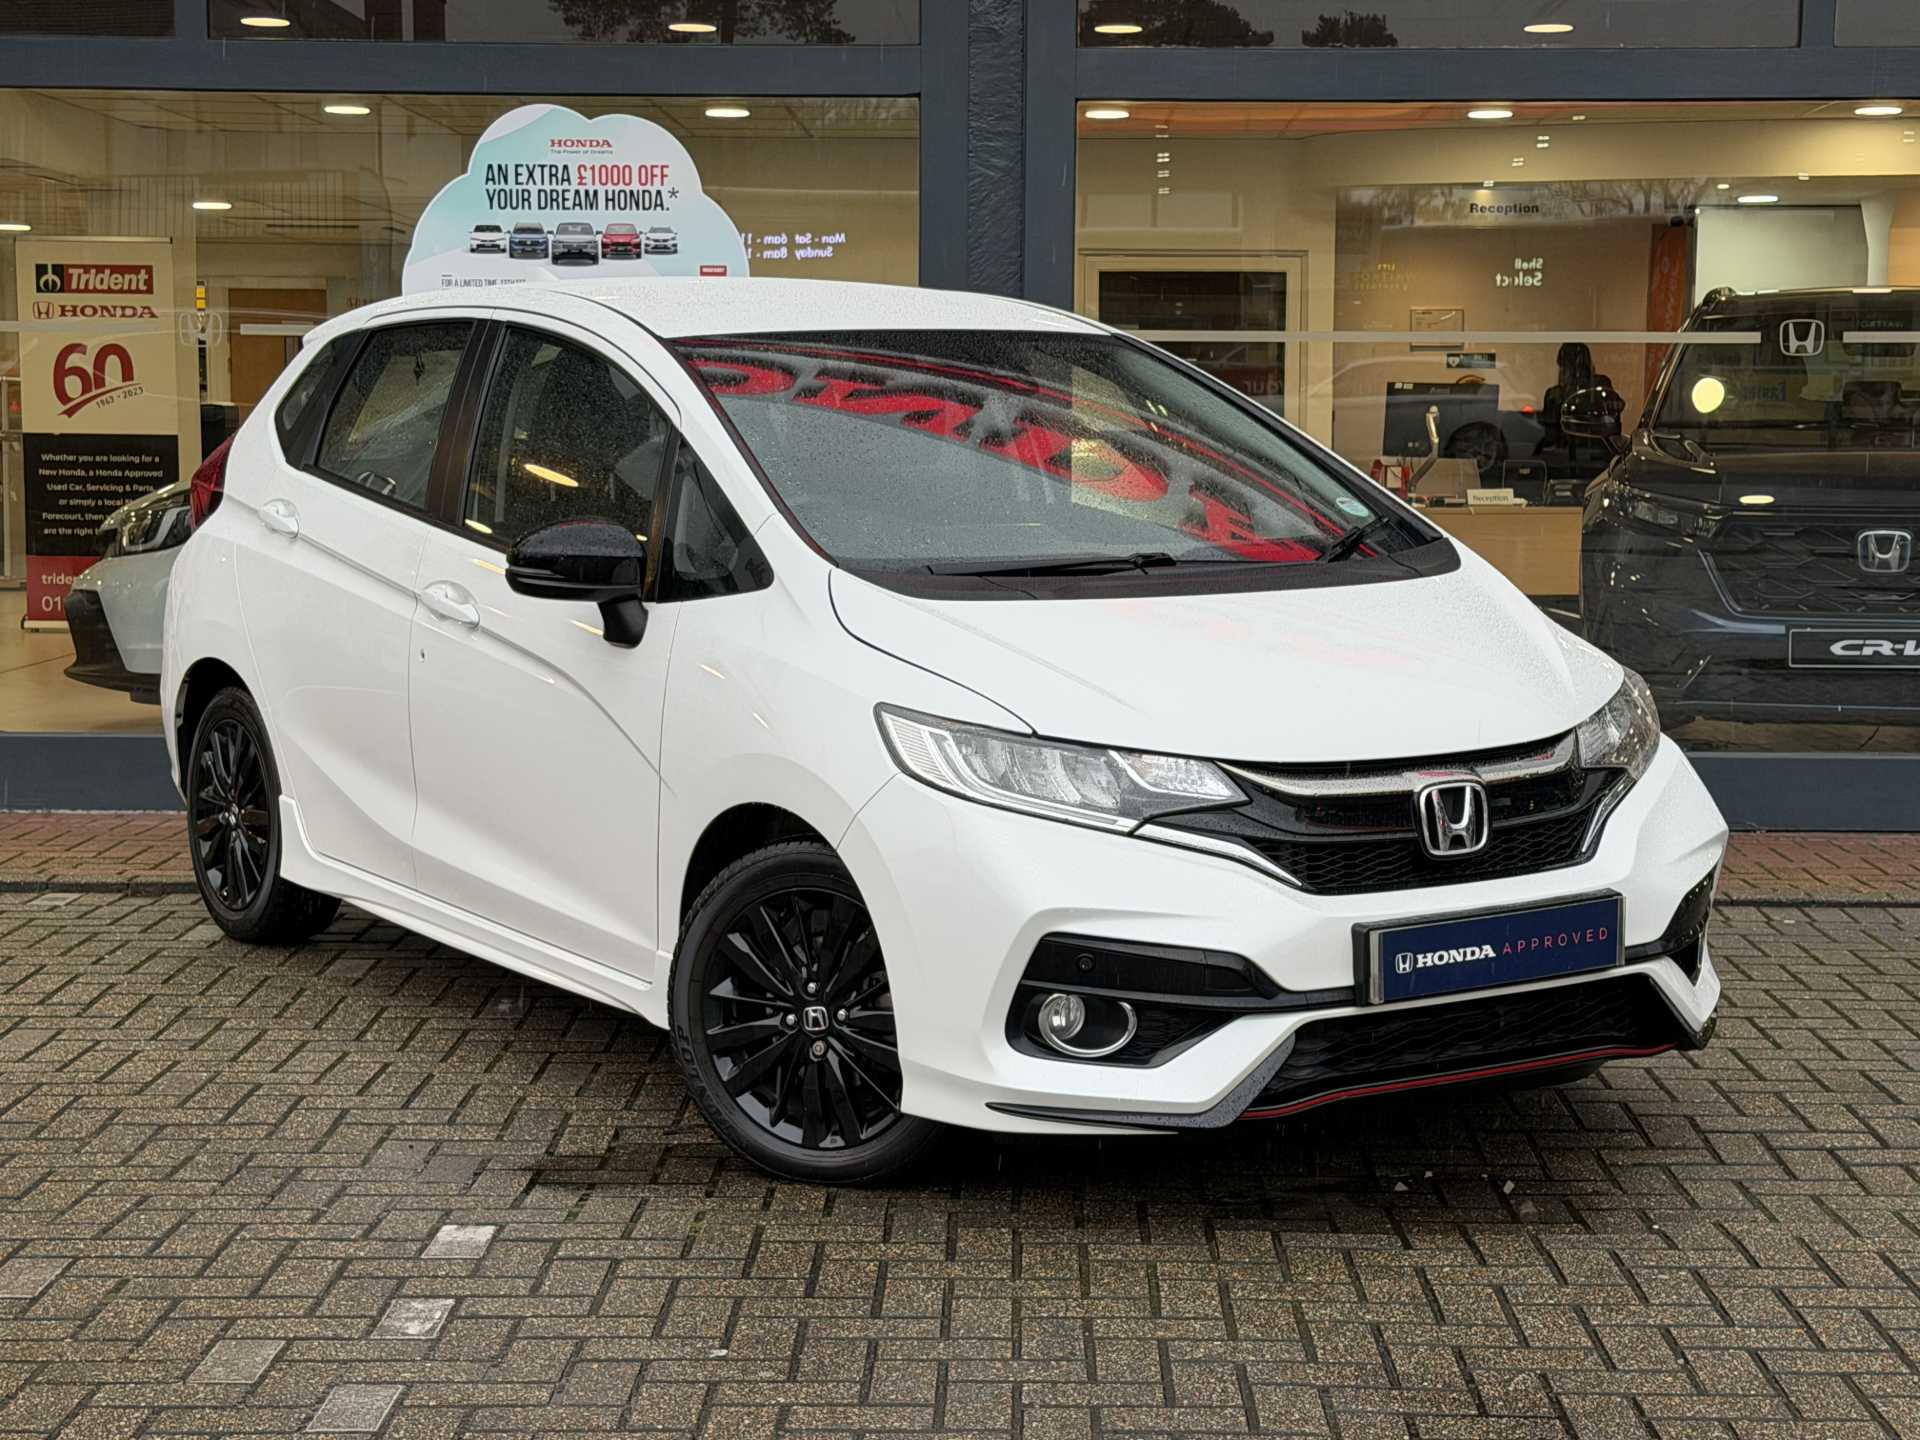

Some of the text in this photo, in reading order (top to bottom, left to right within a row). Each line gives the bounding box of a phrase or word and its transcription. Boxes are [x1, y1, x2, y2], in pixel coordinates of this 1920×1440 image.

[550, 139, 612, 148] HONDA
[485, 163, 670, 186] AN EXTRA £1000 OFF
[485, 188, 531, 210] YOUR
[537, 189, 599, 211] DREAM
[1470, 203, 1539, 215] Reception
[68, 268, 149, 291] Trident
[58, 304, 159, 319] HONDA
[53, 343, 134, 406] 60
[41, 453, 77, 462] Whether
[78, 455, 94, 463] you
[109, 453, 140, 463] looking
[96, 469, 122, 477] Honda
[124, 469, 163, 478] Approved
[46, 483, 67, 491] Used
[86, 483, 124, 492] Servicing
[74, 528, 93, 537] right
[41, 572, 77, 585] tride
[1416, 927, 1608, 968] HONDA APPROVED
